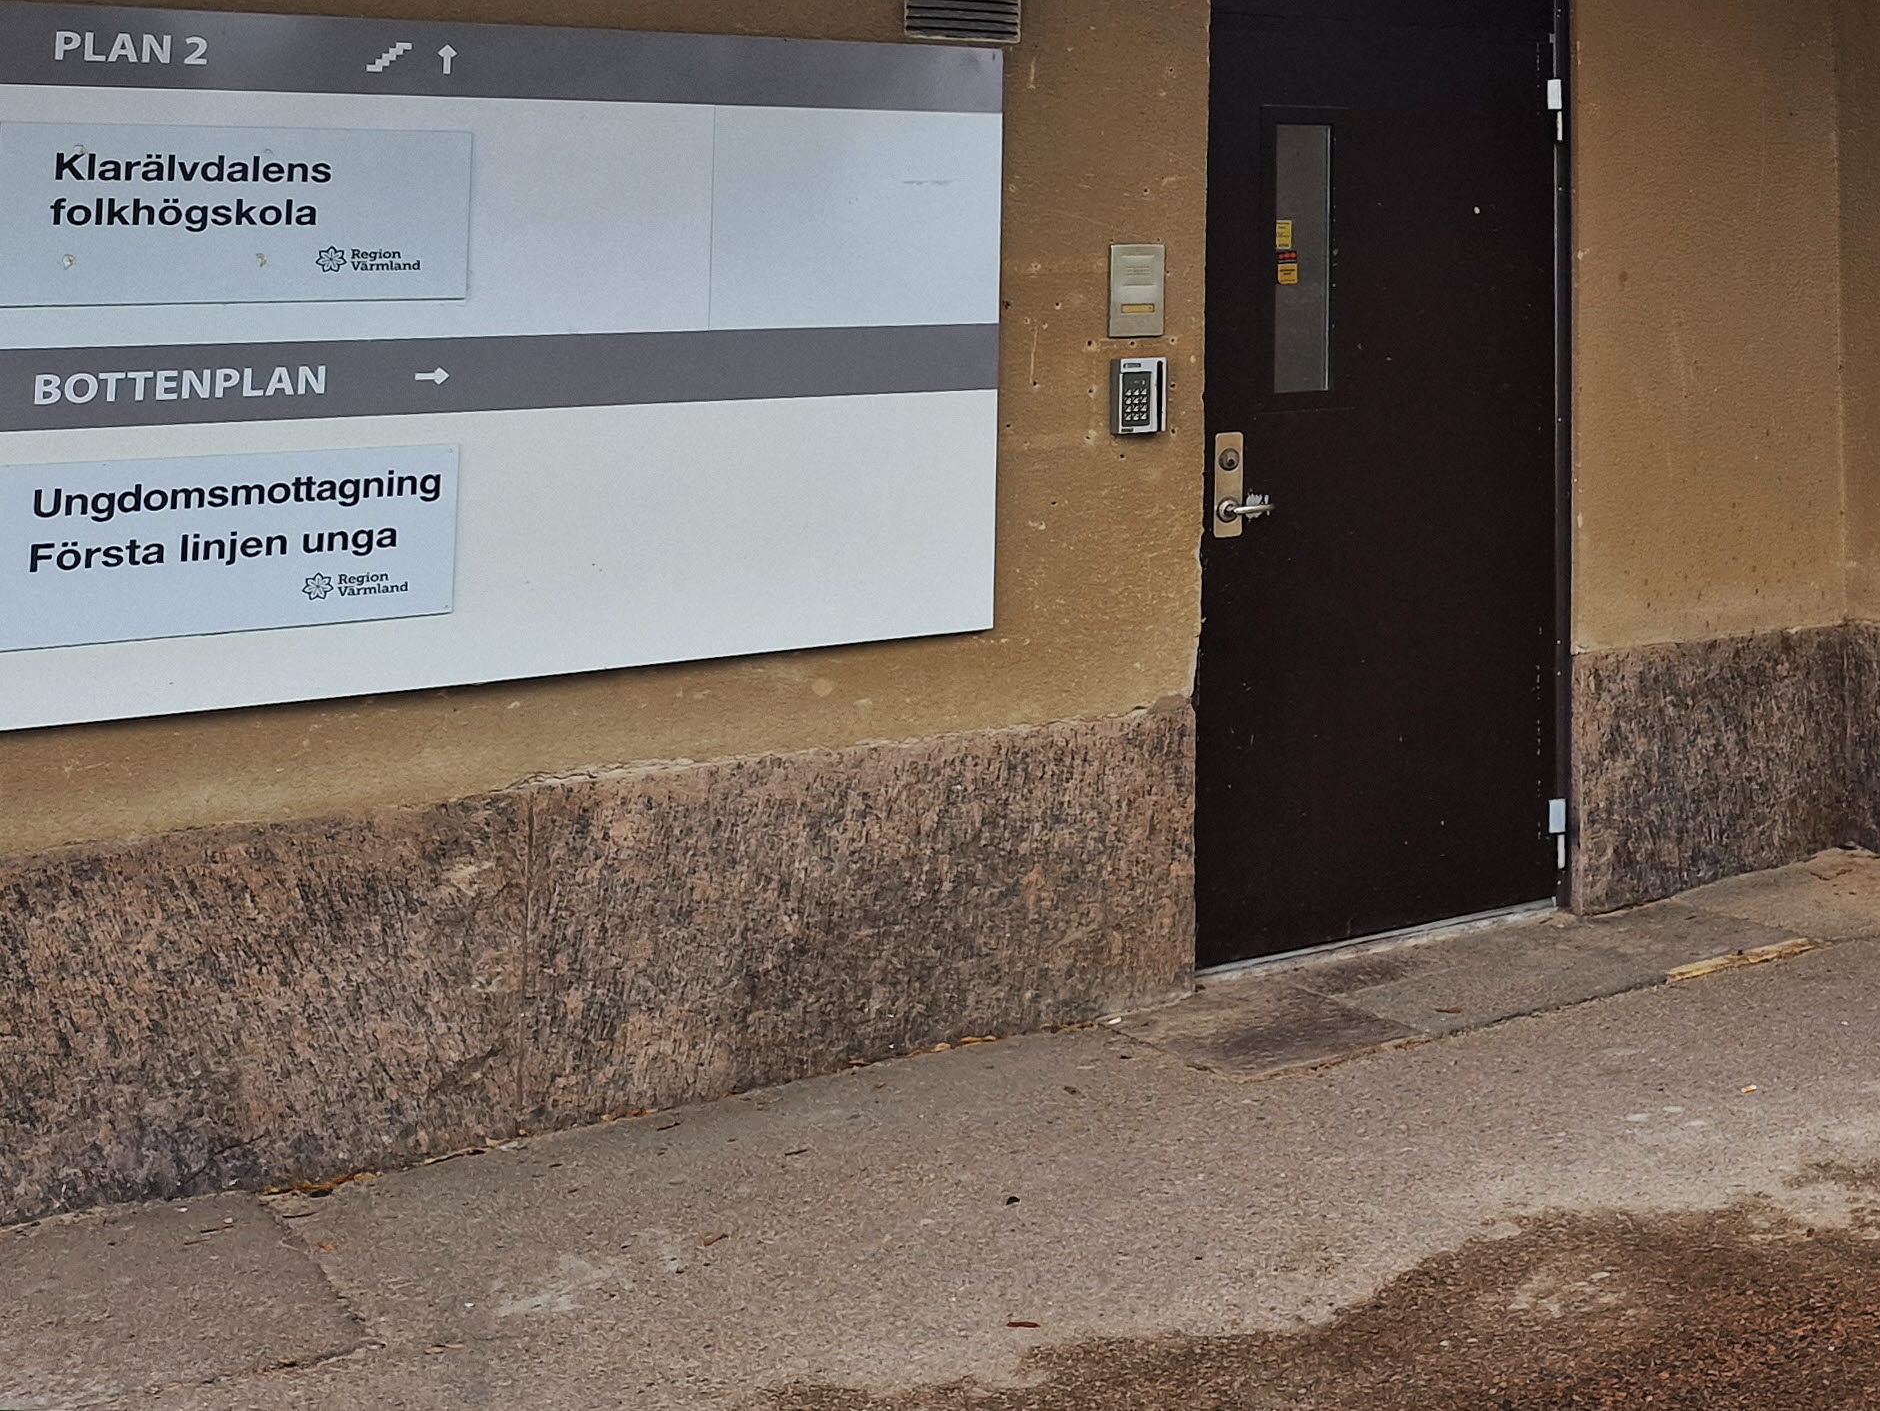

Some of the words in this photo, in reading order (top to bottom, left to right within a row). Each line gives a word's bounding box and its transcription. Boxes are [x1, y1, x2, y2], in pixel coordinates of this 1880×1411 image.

[53, 30, 172, 65] PLAN
[183, 35, 209, 66] 2
[54, 152, 333, 184] Klarälvdalens
[50, 197, 318, 233] folkhögskola
[350, 248, 402, 262] Region
[350, 259, 421, 272] Värmland
[33, 365, 327, 406] BOTTENPLAN
[33, 469, 442, 522] Ungdomsmottagning
[29, 537, 165, 573] Första
[180, 531, 288, 566] linjen
[302, 527, 398, 556] unga
[337, 571, 390, 586] Region
[337, 581, 409, 598] Värmland
